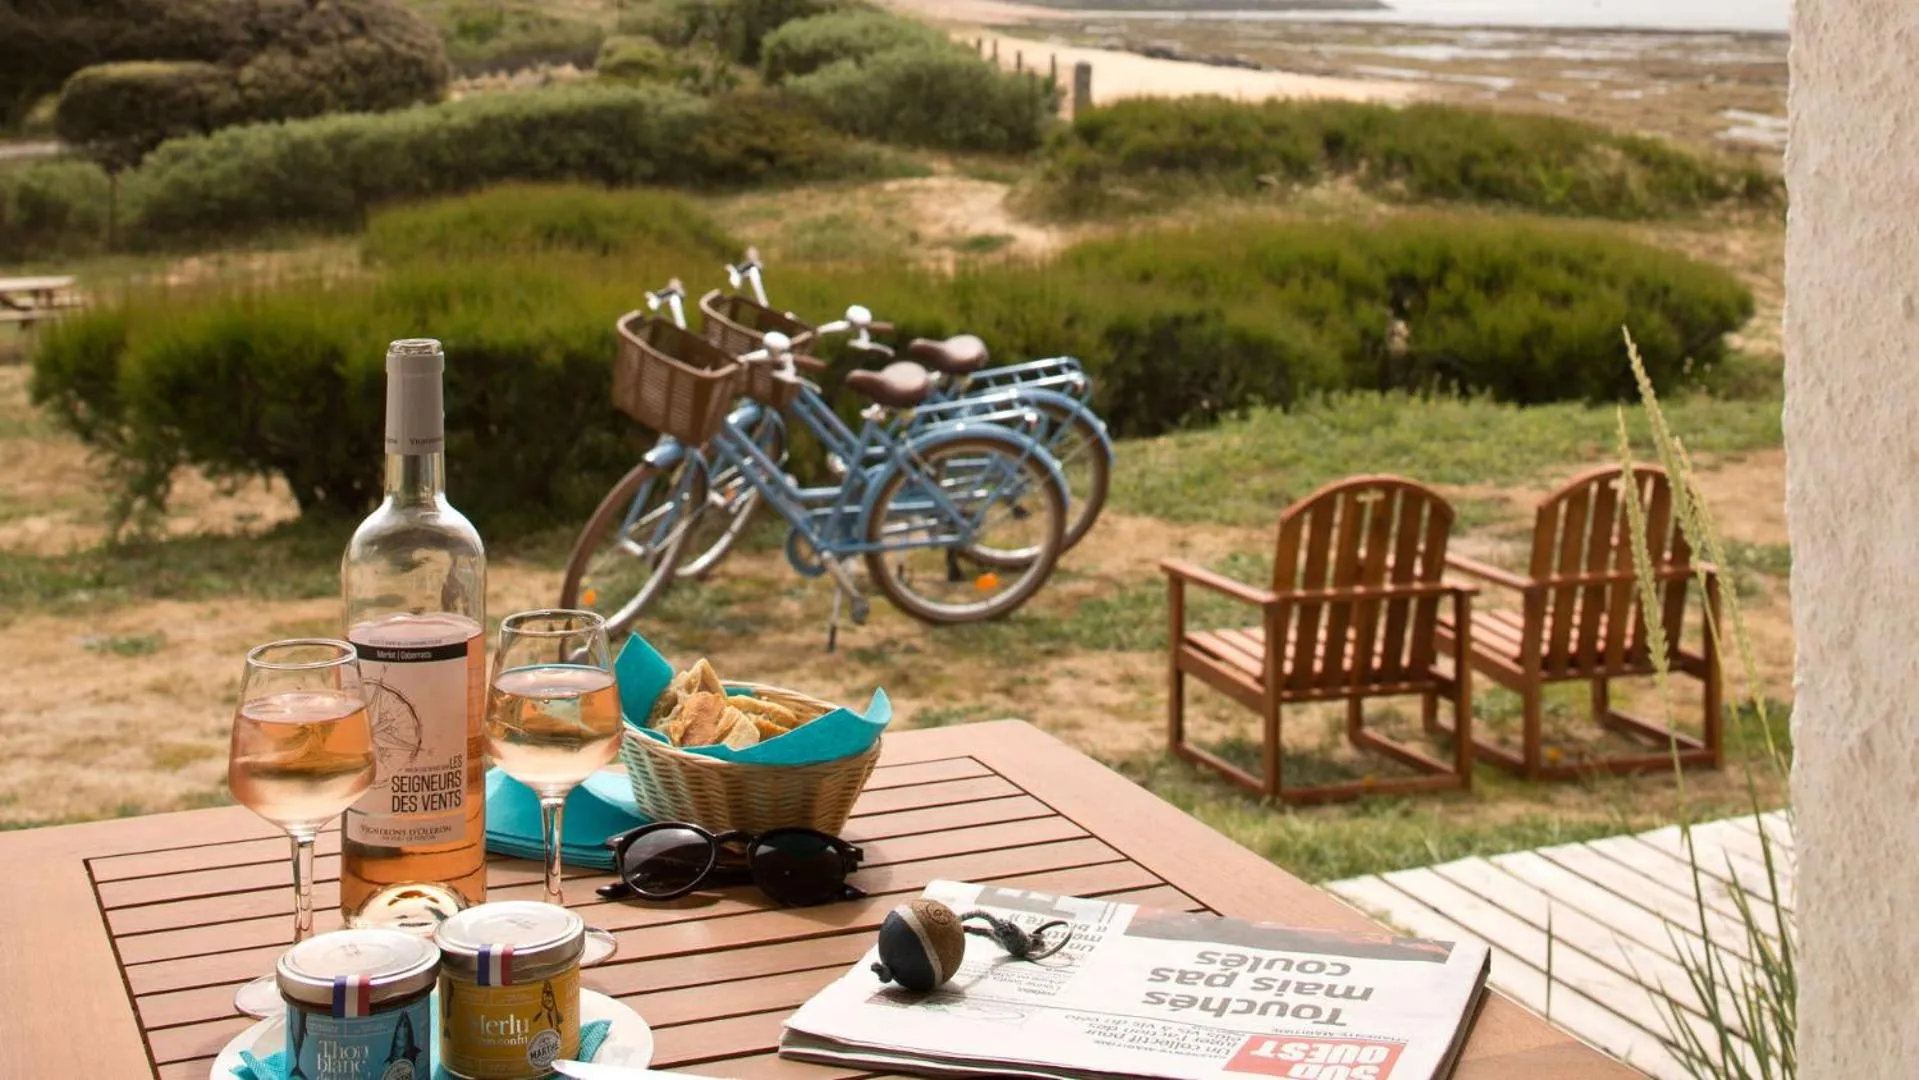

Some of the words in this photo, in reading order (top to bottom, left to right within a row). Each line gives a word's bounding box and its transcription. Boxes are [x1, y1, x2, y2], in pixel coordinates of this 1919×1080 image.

[449, 755, 463, 769] LES
[391, 770, 462, 793] SEIGNEURS
[391, 795, 418, 813] DES
[421, 790, 462, 811] VENTS
[1192, 950, 1352, 978] coulés
[1145, 967, 1239, 989] pas
[1250, 976, 1375, 1002] mais
[1141, 990, 1347, 1027] Touchés
[478, 1013, 530, 1036] erlu
[1083, 1028, 1126, 1041] pour
[317, 1039, 369, 1060] Thon
[1128, 1035, 1201, 1051] collectif
[1206, 1045, 1232, 1056] Un
[1250, 1039, 1390, 1064] OUEST
[1286, 1062, 1381, 1080] SUD
